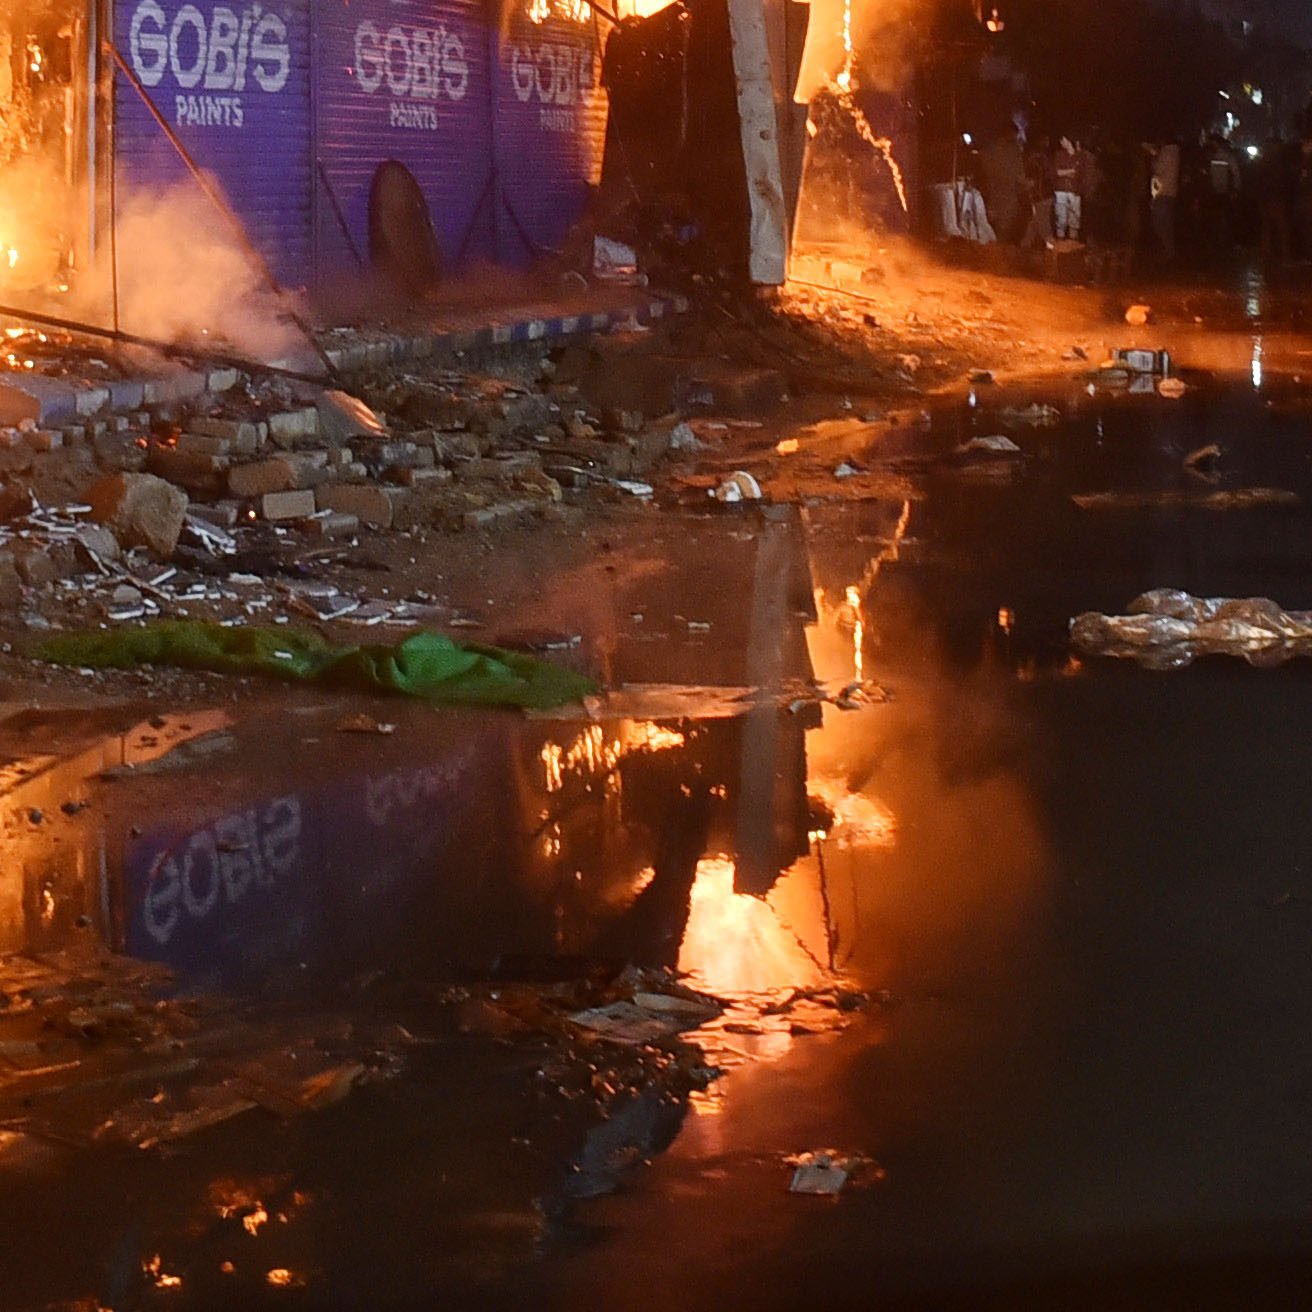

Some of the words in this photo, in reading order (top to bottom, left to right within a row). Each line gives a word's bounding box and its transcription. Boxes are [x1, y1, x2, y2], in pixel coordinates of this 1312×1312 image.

[353, 20, 469, 100] GOBI'S
[174, 94, 245, 127] PAINTS
[389, 101, 439, 131] PAINTS
